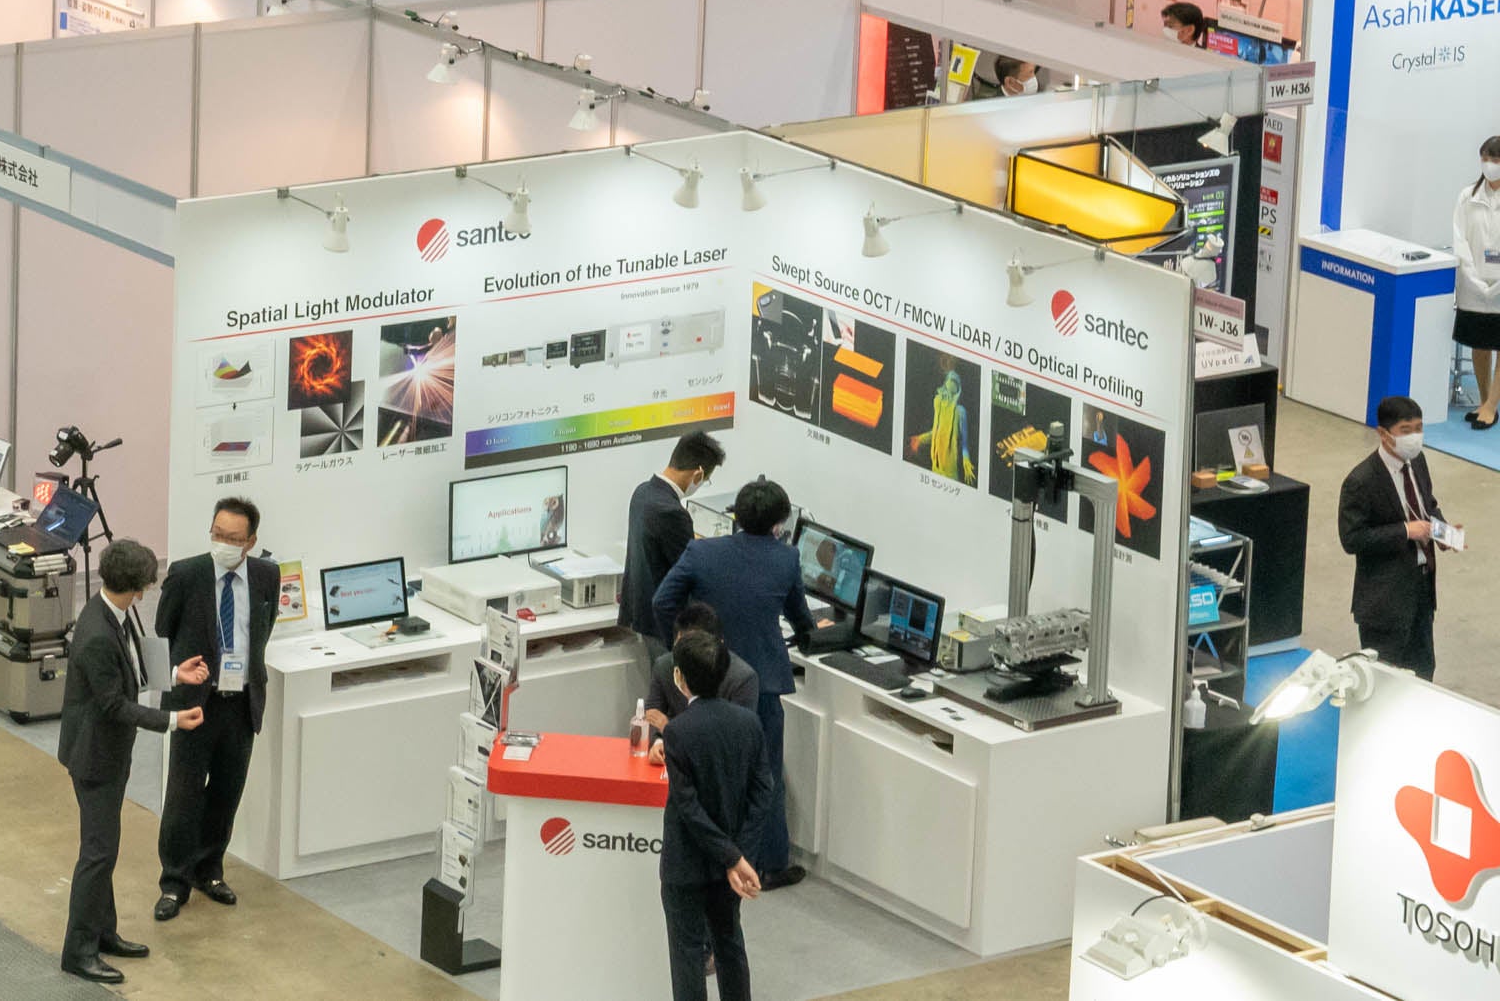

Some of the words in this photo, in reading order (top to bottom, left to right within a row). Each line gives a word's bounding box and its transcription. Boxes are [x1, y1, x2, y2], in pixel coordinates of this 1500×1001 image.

[1392, 46, 1437, 73] Crystal
[1453, 45, 1466, 63] IS
[483, 267, 561, 294] Evolution
[565, 263, 583, 283] of
[586, 260, 613, 280] the
[616, 253, 680, 276] Tunable
[683, 245, 728, 267] Laser
[1321, 260, 1376, 287] INFORMATION
[620, 289, 659, 301] Innovation
[661, 285, 680, 295] Since
[226, 303, 288, 330] Spatial
[295, 297, 340, 321] Light
[346, 286, 435, 312] Modulator
[771, 255, 812, 286] Swept
[813, 271, 860, 301] Source
[863, 288, 893, 315] OCT
[904, 303, 946, 331] FMCW
[951, 319, 992, 349] LiDAR
[1004, 338, 1024, 361] 3D
[1028, 347, 1078, 383] Optical
[1083, 367, 1144, 409] Profiling
[1085, 313, 1150, 351] santec
[487, 404, 560, 424] シリコンフォトニクス
[919, 473, 930, 486] 3D
[487, 505, 533, 520] Applications
[583, 830, 662, 856] santec
[1397, 892, 1498, 964] TOSOH
